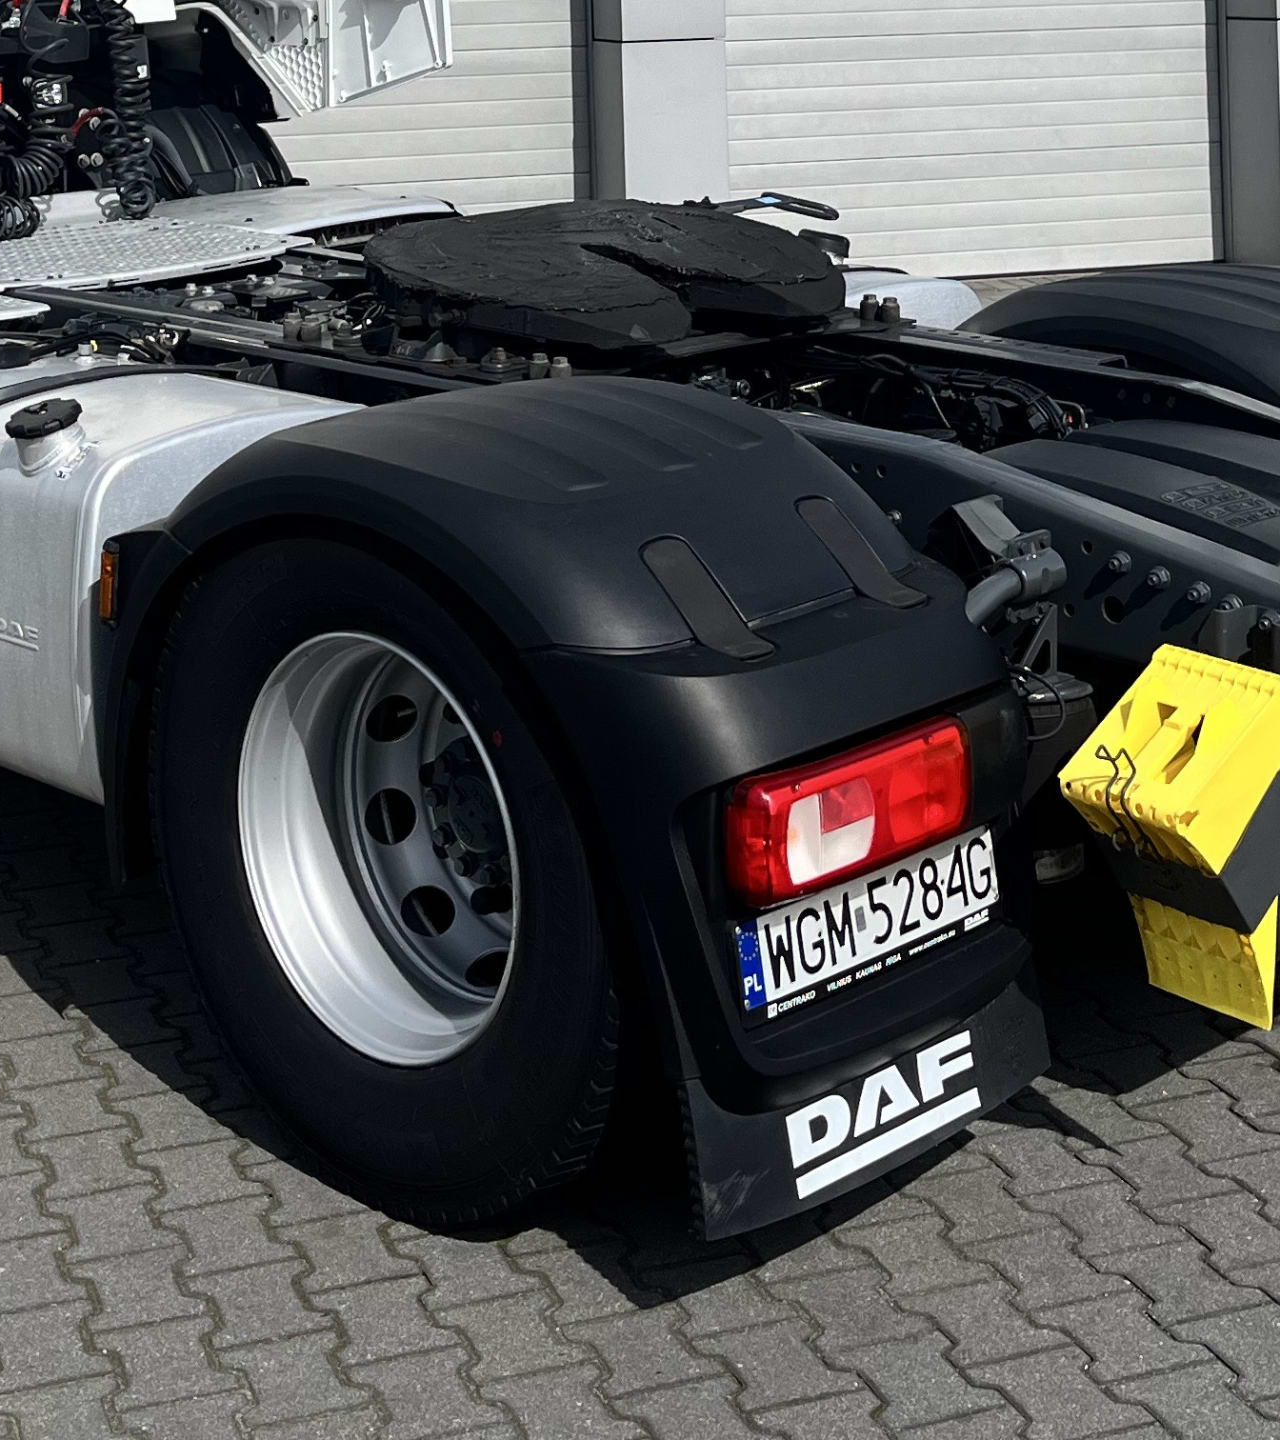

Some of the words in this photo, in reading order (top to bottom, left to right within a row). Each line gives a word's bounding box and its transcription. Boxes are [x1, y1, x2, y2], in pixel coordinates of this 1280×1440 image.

[763, 891, 857, 990] WGM
[866, 836, 992, 945] 5284G
[743, 973, 763, 996] PL
[785, 1030, 975, 1170] DAF
